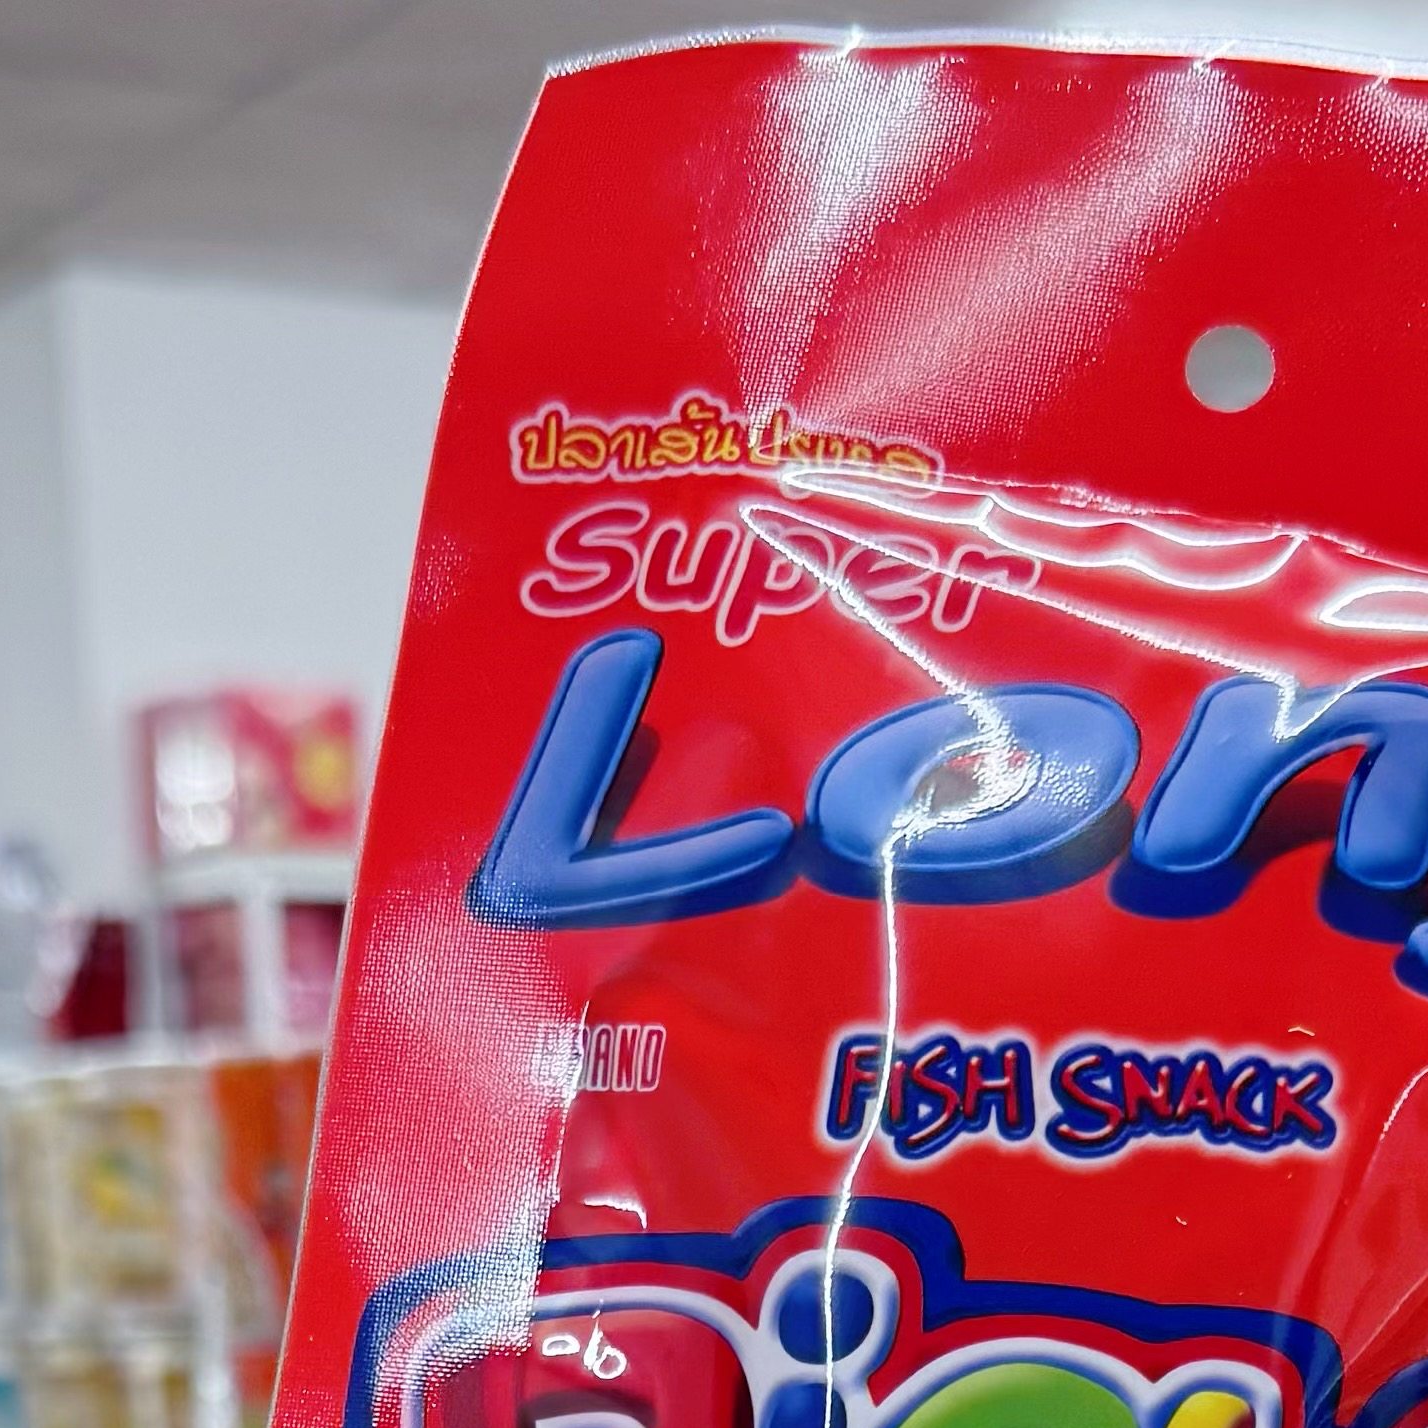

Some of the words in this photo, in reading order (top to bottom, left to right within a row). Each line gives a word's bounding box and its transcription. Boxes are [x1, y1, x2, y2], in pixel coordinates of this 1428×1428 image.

[522, 502, 1042, 647] Super
[825, 1034, 1036, 1160] FISH
[1045, 1044, 1336, 1160] SNACK
